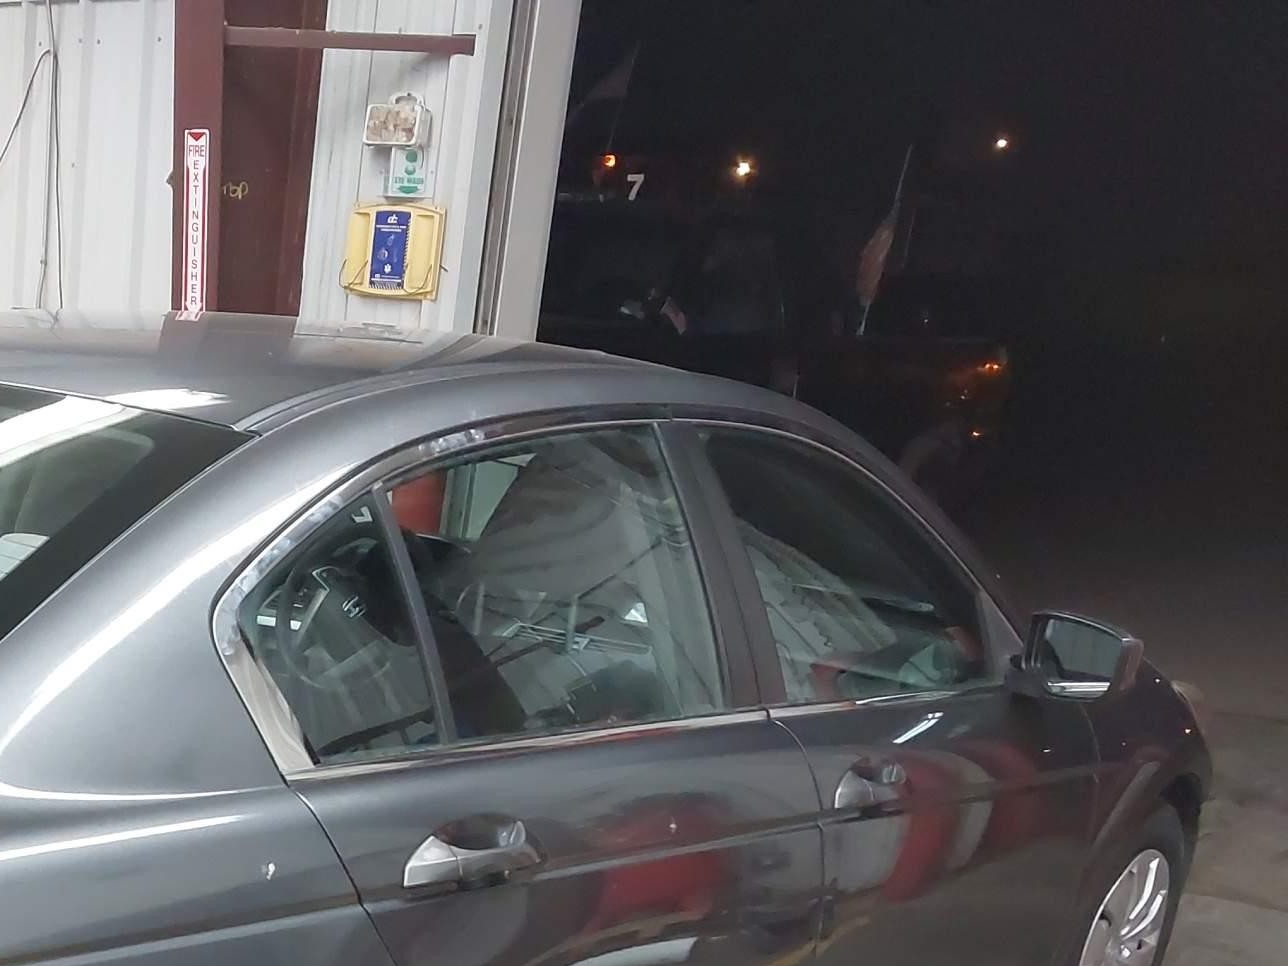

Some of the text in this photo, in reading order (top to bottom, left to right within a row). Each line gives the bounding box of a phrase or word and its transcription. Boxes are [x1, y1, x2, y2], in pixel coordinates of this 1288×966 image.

[188, 145, 205, 157] FIRE
[627, 174, 645, 201] 7
[190, 160, 200, 306] EXTINGUISHER
